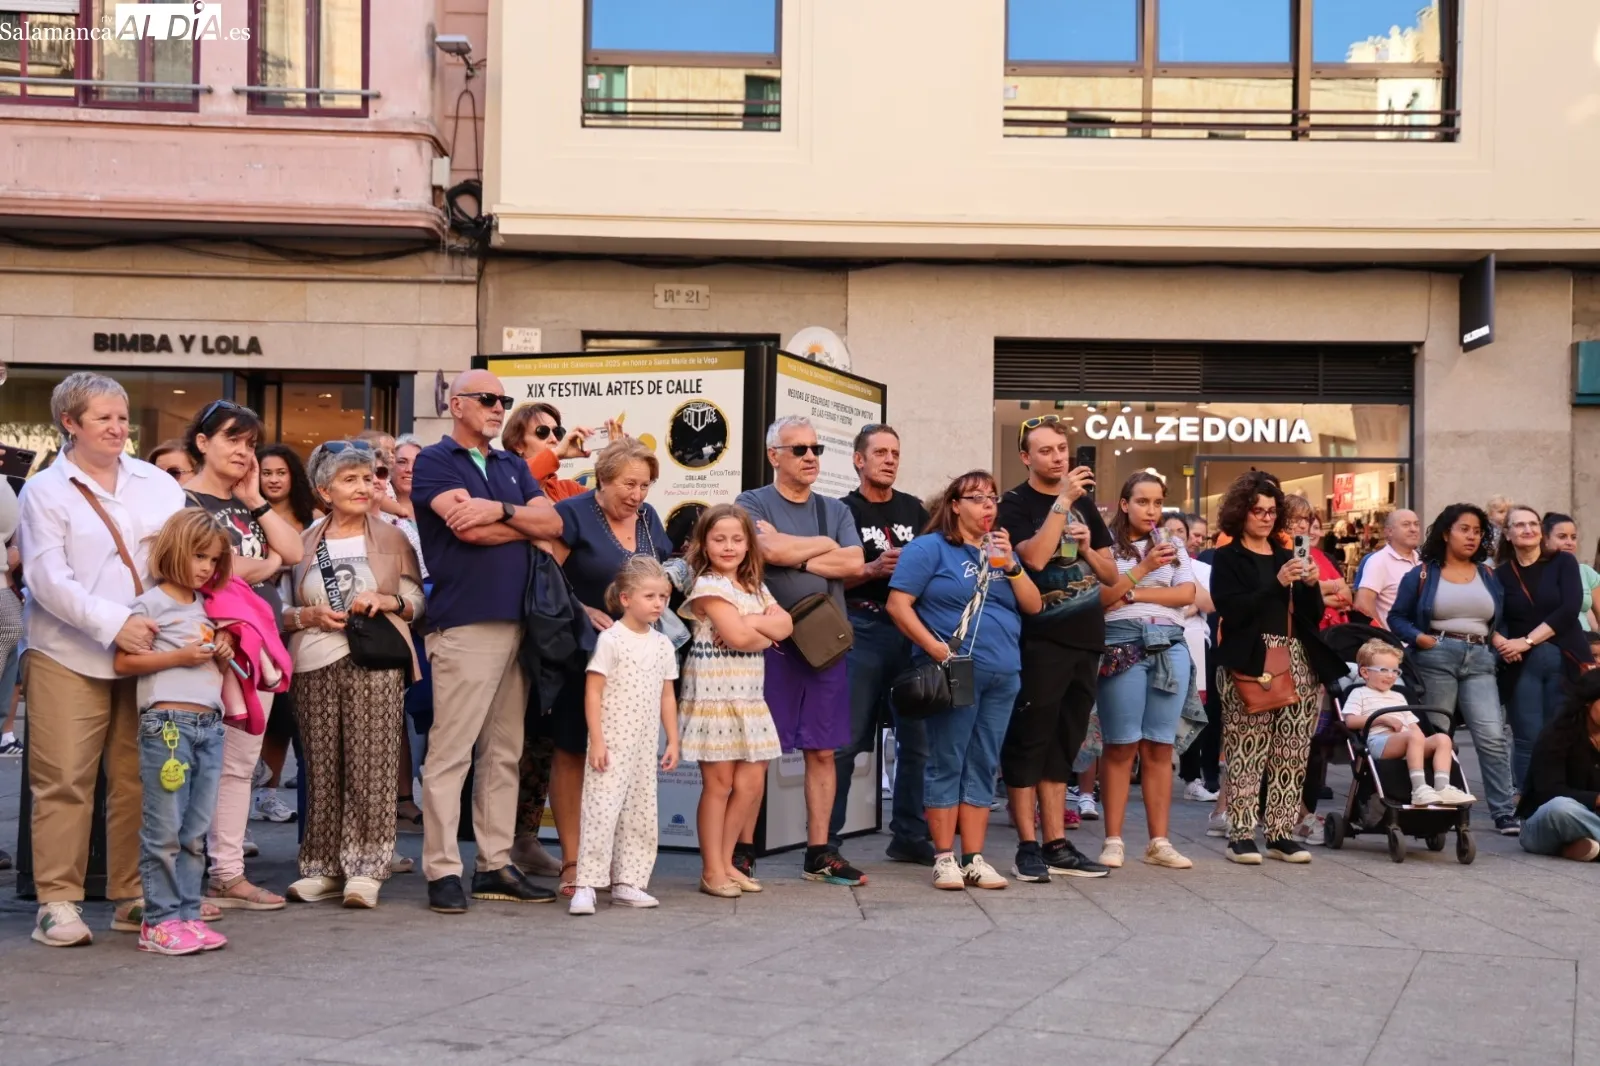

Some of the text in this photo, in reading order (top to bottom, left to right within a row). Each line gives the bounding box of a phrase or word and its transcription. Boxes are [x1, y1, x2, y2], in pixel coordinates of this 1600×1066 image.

[685, 290, 700, 303] 21
[93, 332, 263, 355] BIMBA Y LOLA
[703, 356, 718, 365] Vega
[526, 378, 703, 398] XIX FESTIVAL ARTES DE CALLE
[1084, 414, 1313, 443] CALZEDONIA
